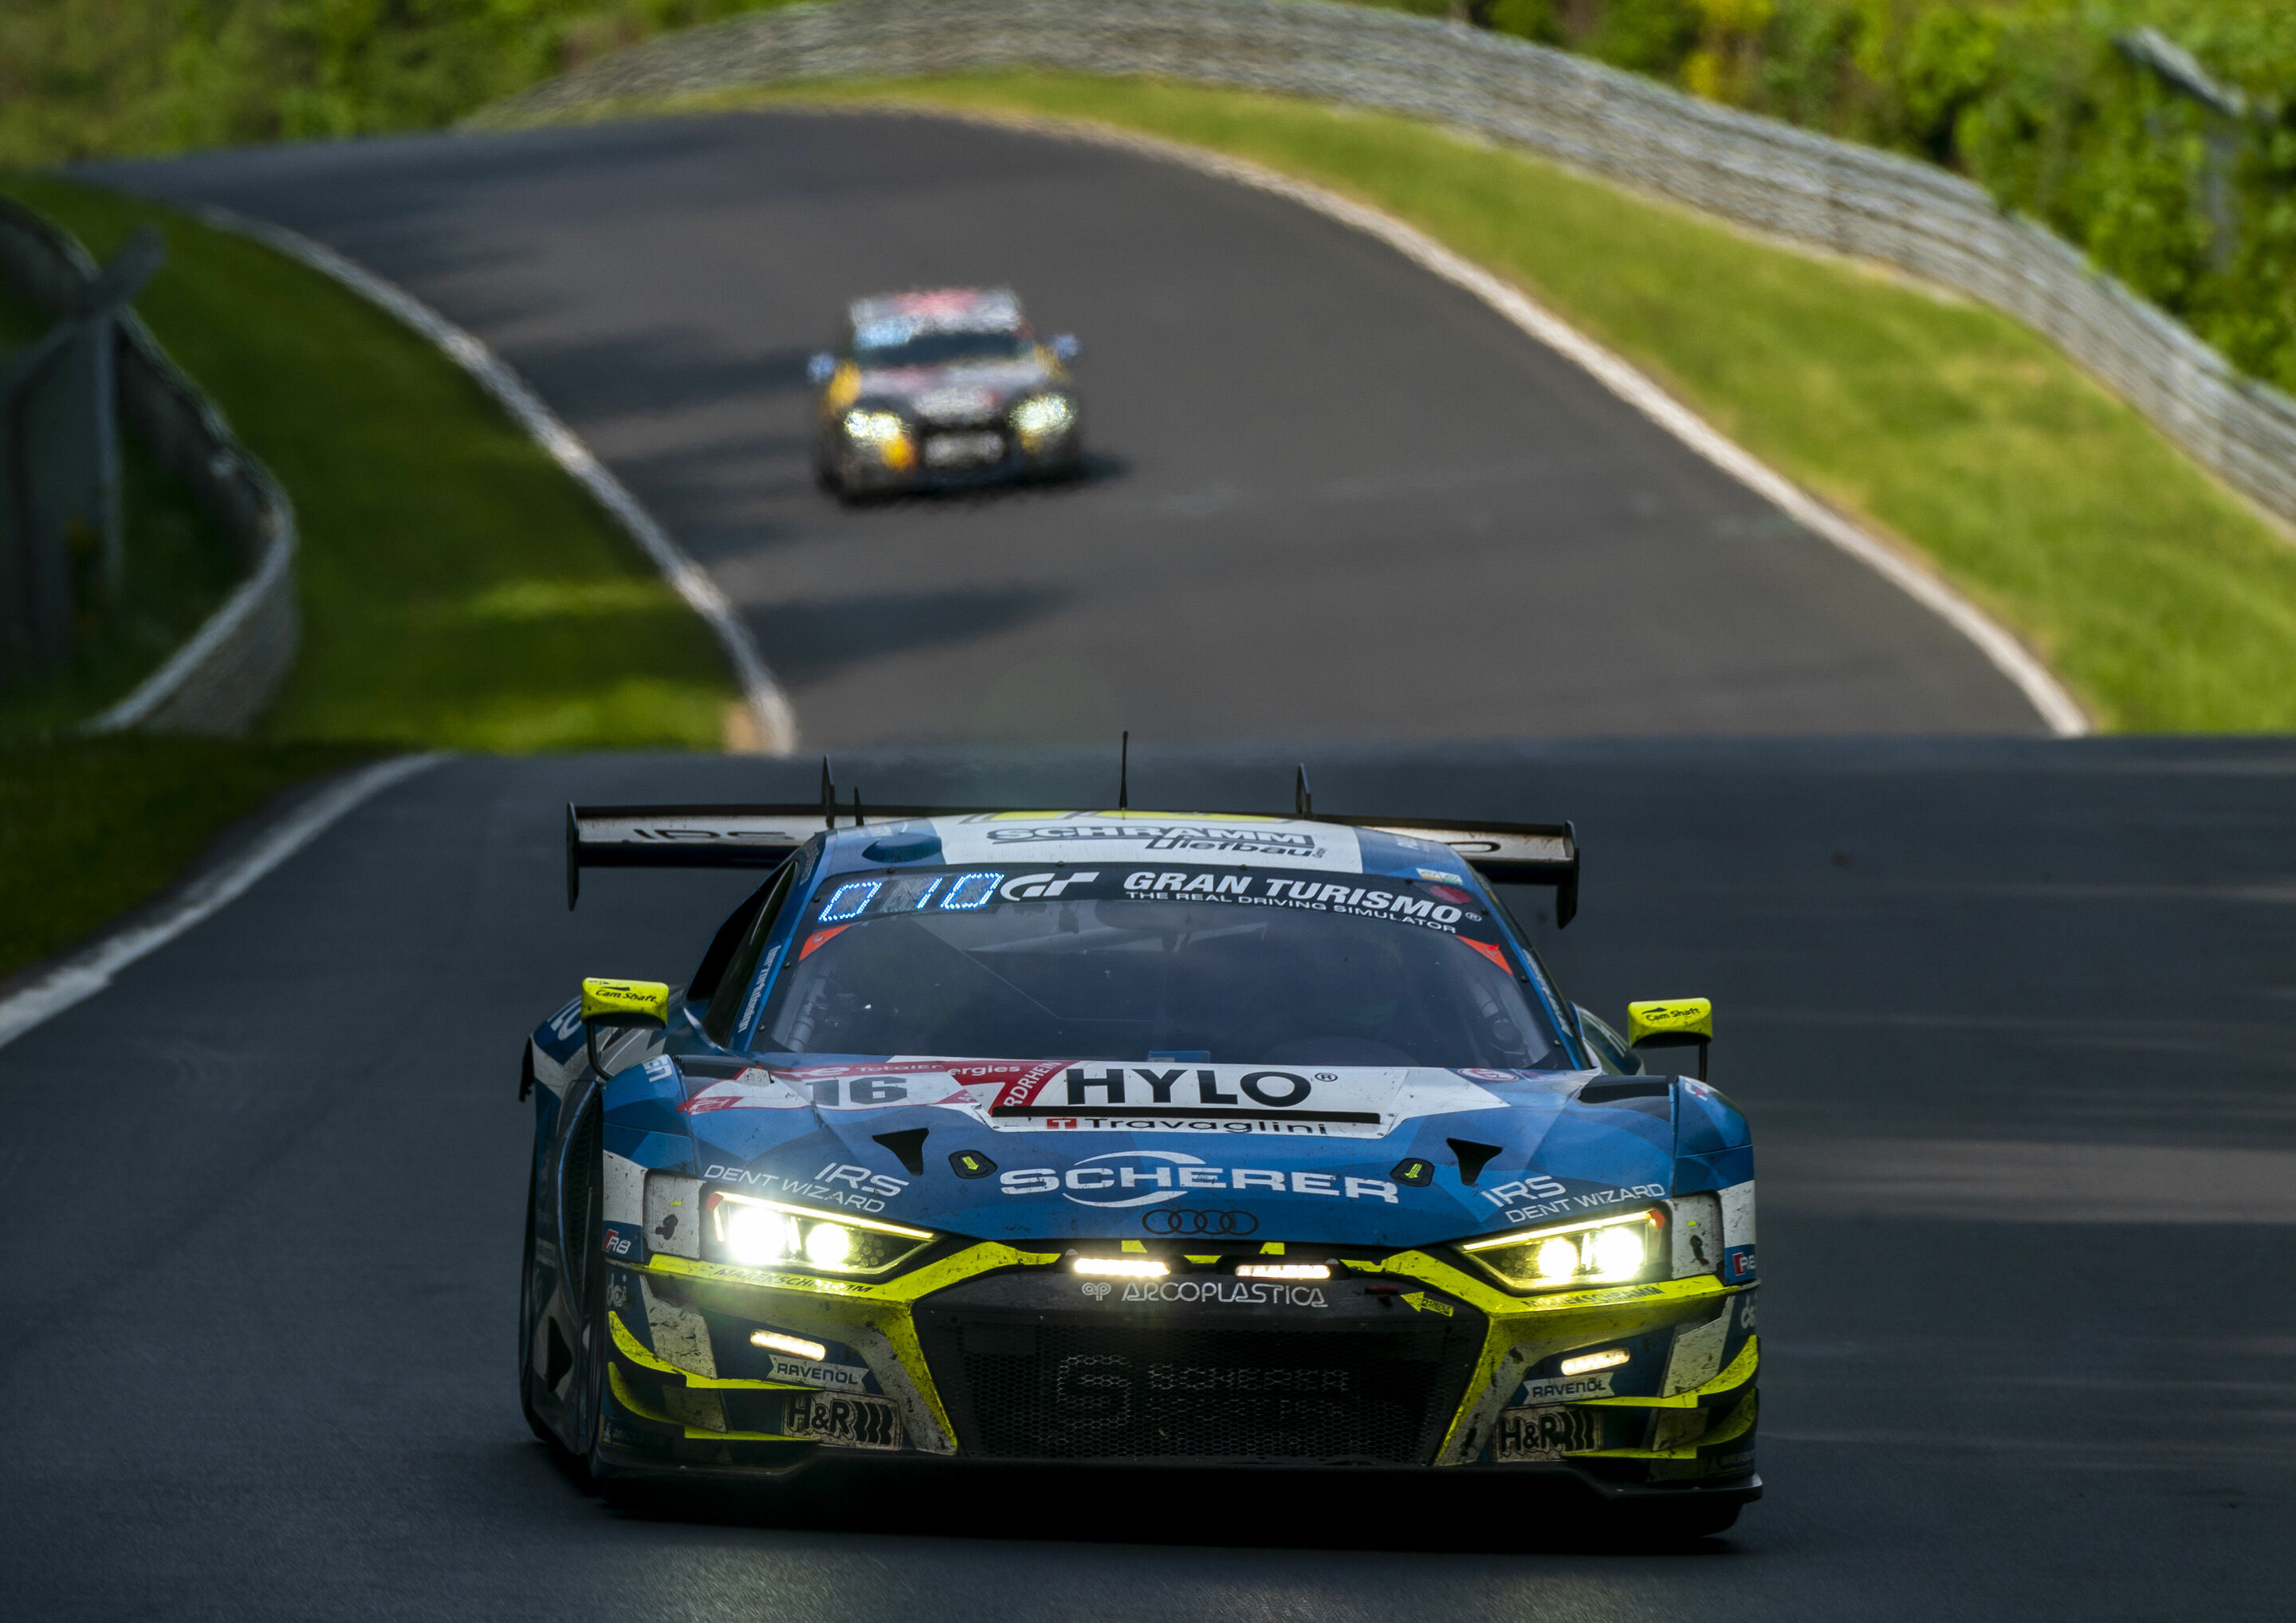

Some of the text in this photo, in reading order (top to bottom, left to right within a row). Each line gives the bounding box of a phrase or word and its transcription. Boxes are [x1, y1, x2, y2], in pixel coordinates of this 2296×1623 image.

[987, 826, 1315, 848] SCHRAMM
[1123, 872, 1252, 894] GRAN
[1126, 891, 1457, 934] THE REAL DRIVING SIMULATOR
[595, 989, 657, 1002] Cam Shaft
[805, 1075, 908, 1106] 16
[1086, 1117, 1327, 1136] Travaglini
[704, 1164, 886, 1214] DENT WIZARD
[815, 1161, 910, 1197] IRS
[1000, 1165, 1400, 1204] SCHERER
[1480, 1174, 1567, 1208] IRS
[1504, 1182, 1666, 1224] DENT WIZARD
[1120, 1281, 1329, 1308] ARCOPLASTICA
[776, 1361, 859, 1385] RAVENOL
[788, 1395, 851, 1436] H&R
[1499, 1415, 1560, 1453] H&R
